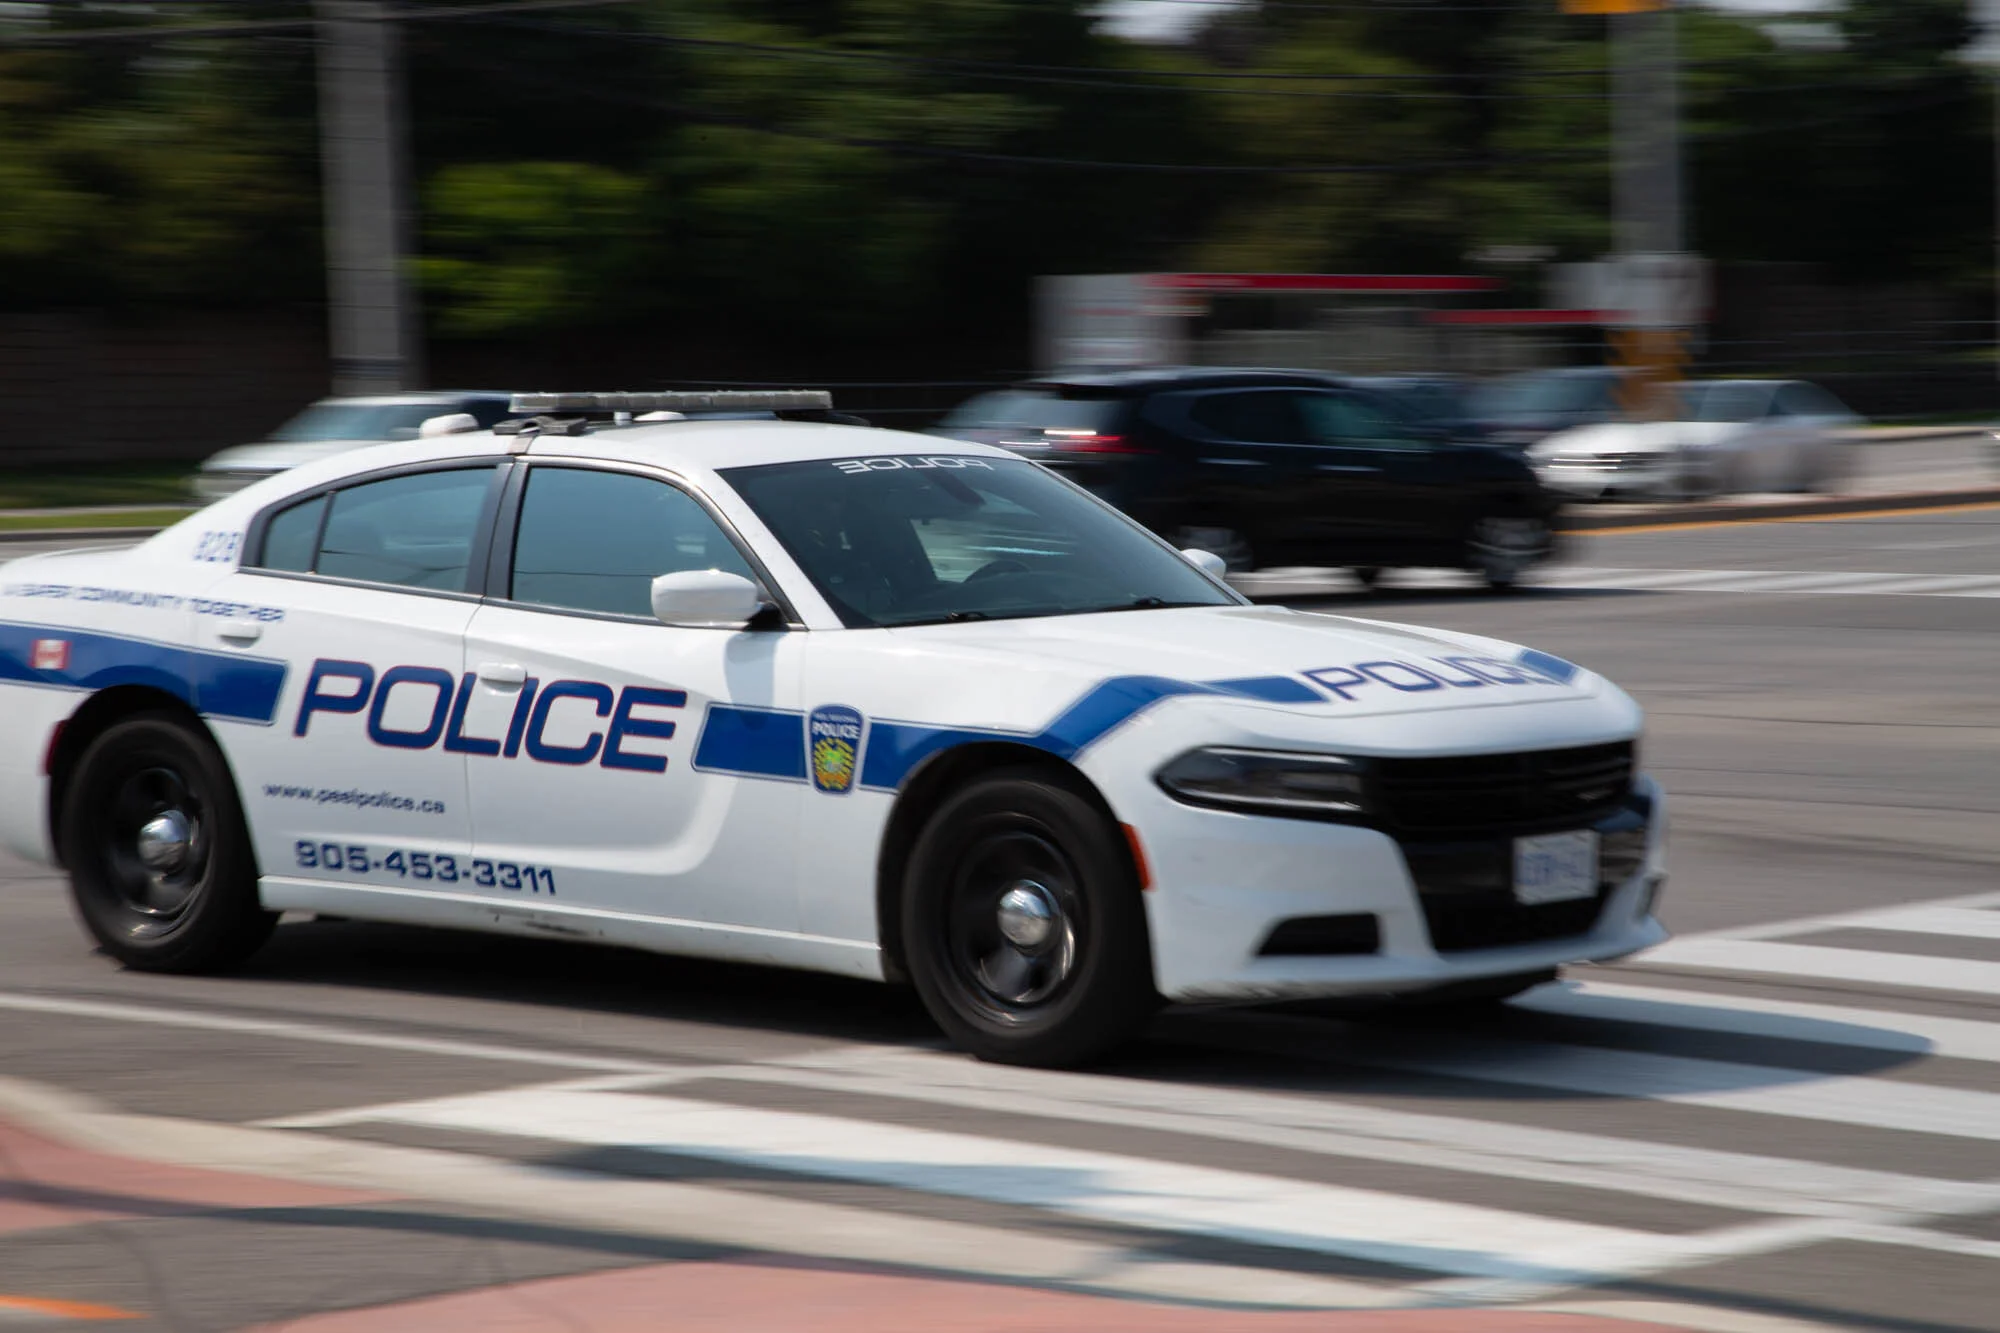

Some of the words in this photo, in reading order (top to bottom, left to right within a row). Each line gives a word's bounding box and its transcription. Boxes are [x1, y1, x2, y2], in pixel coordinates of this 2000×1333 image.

[189, 597, 285, 623] TOGETHER
[293, 658, 688, 773] POLICE
[811, 721, 861, 740] POLICE
[263, 784, 445, 814] www.peelpolice.ca
[295, 839, 556, 896] 905-453-3311
